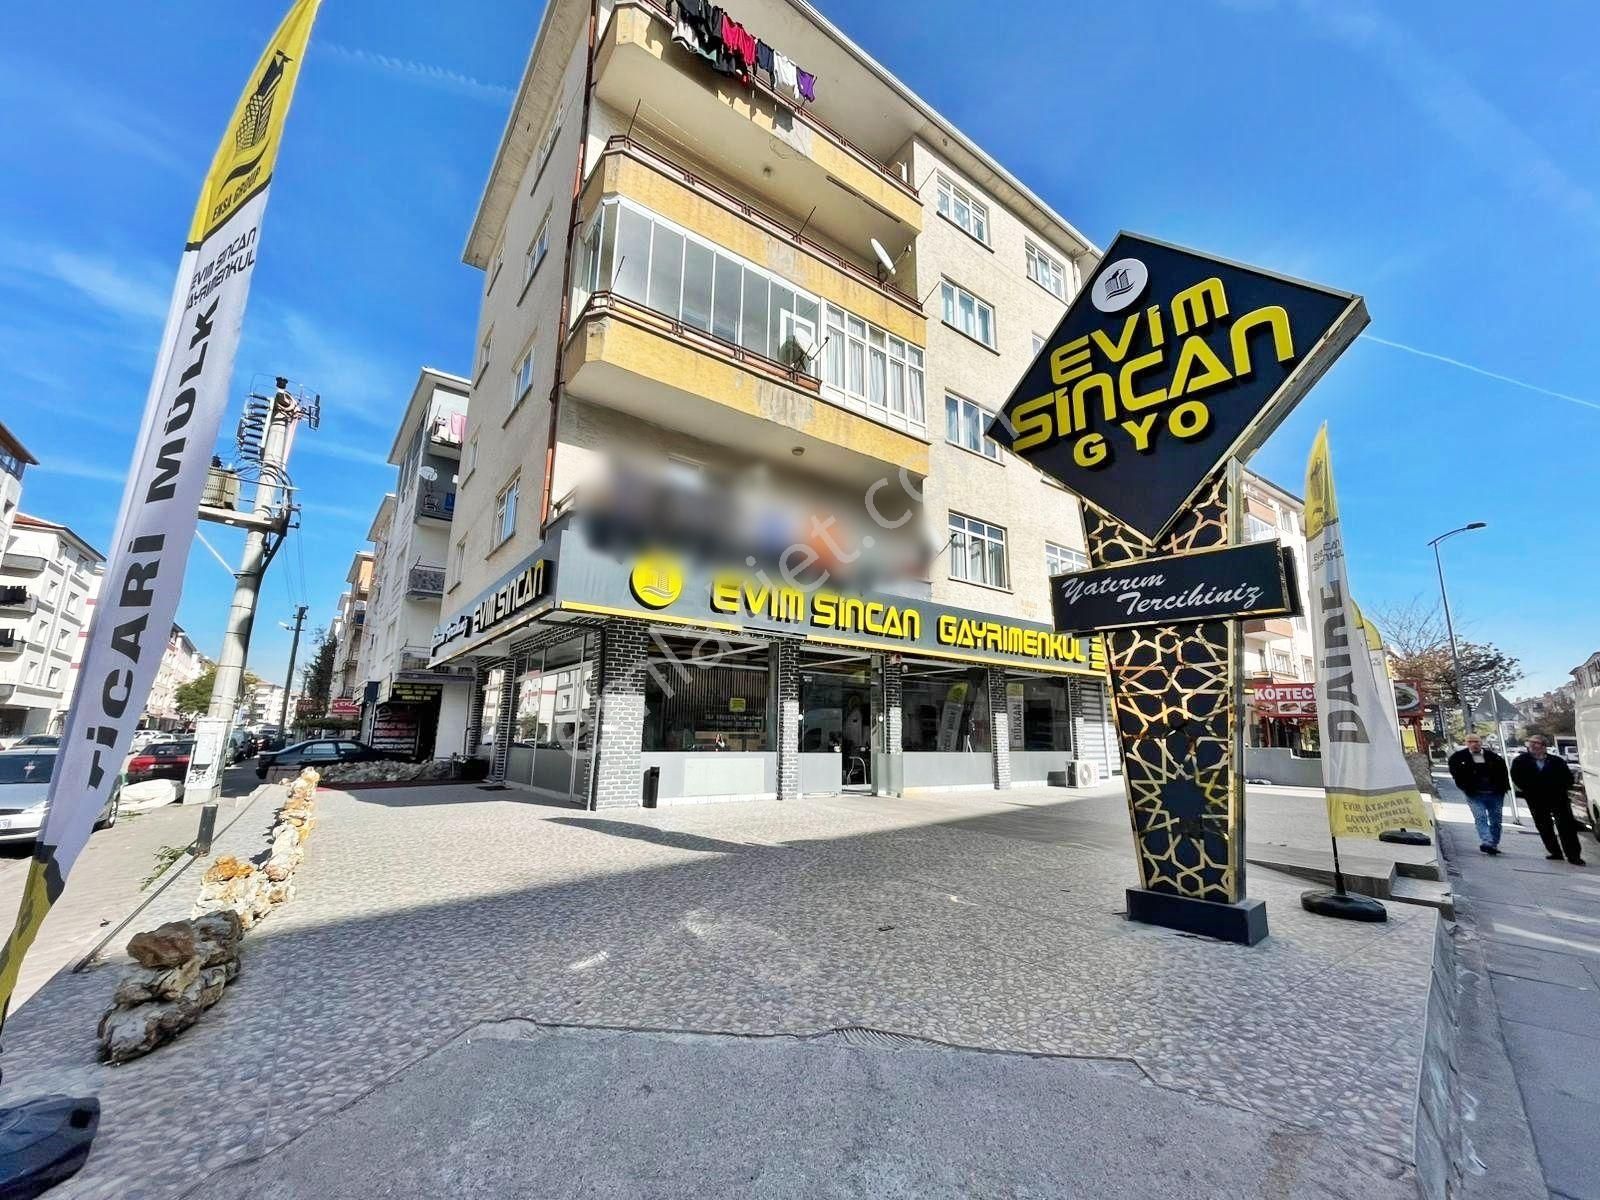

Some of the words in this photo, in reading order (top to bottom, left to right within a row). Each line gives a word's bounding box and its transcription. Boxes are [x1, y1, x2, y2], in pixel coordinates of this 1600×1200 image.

[1050, 277, 1229, 385] EVİM
[144, 295, 220, 504] MÜLK
[1010, 305, 1295, 452] SİNCAN
[1073, 400, 1209, 468] GYO
[811, 590, 921, 641] SİNCAN
[1061, 572, 1166, 605] Yatırım
[1117, 582, 1264, 616] Tercihiniz
